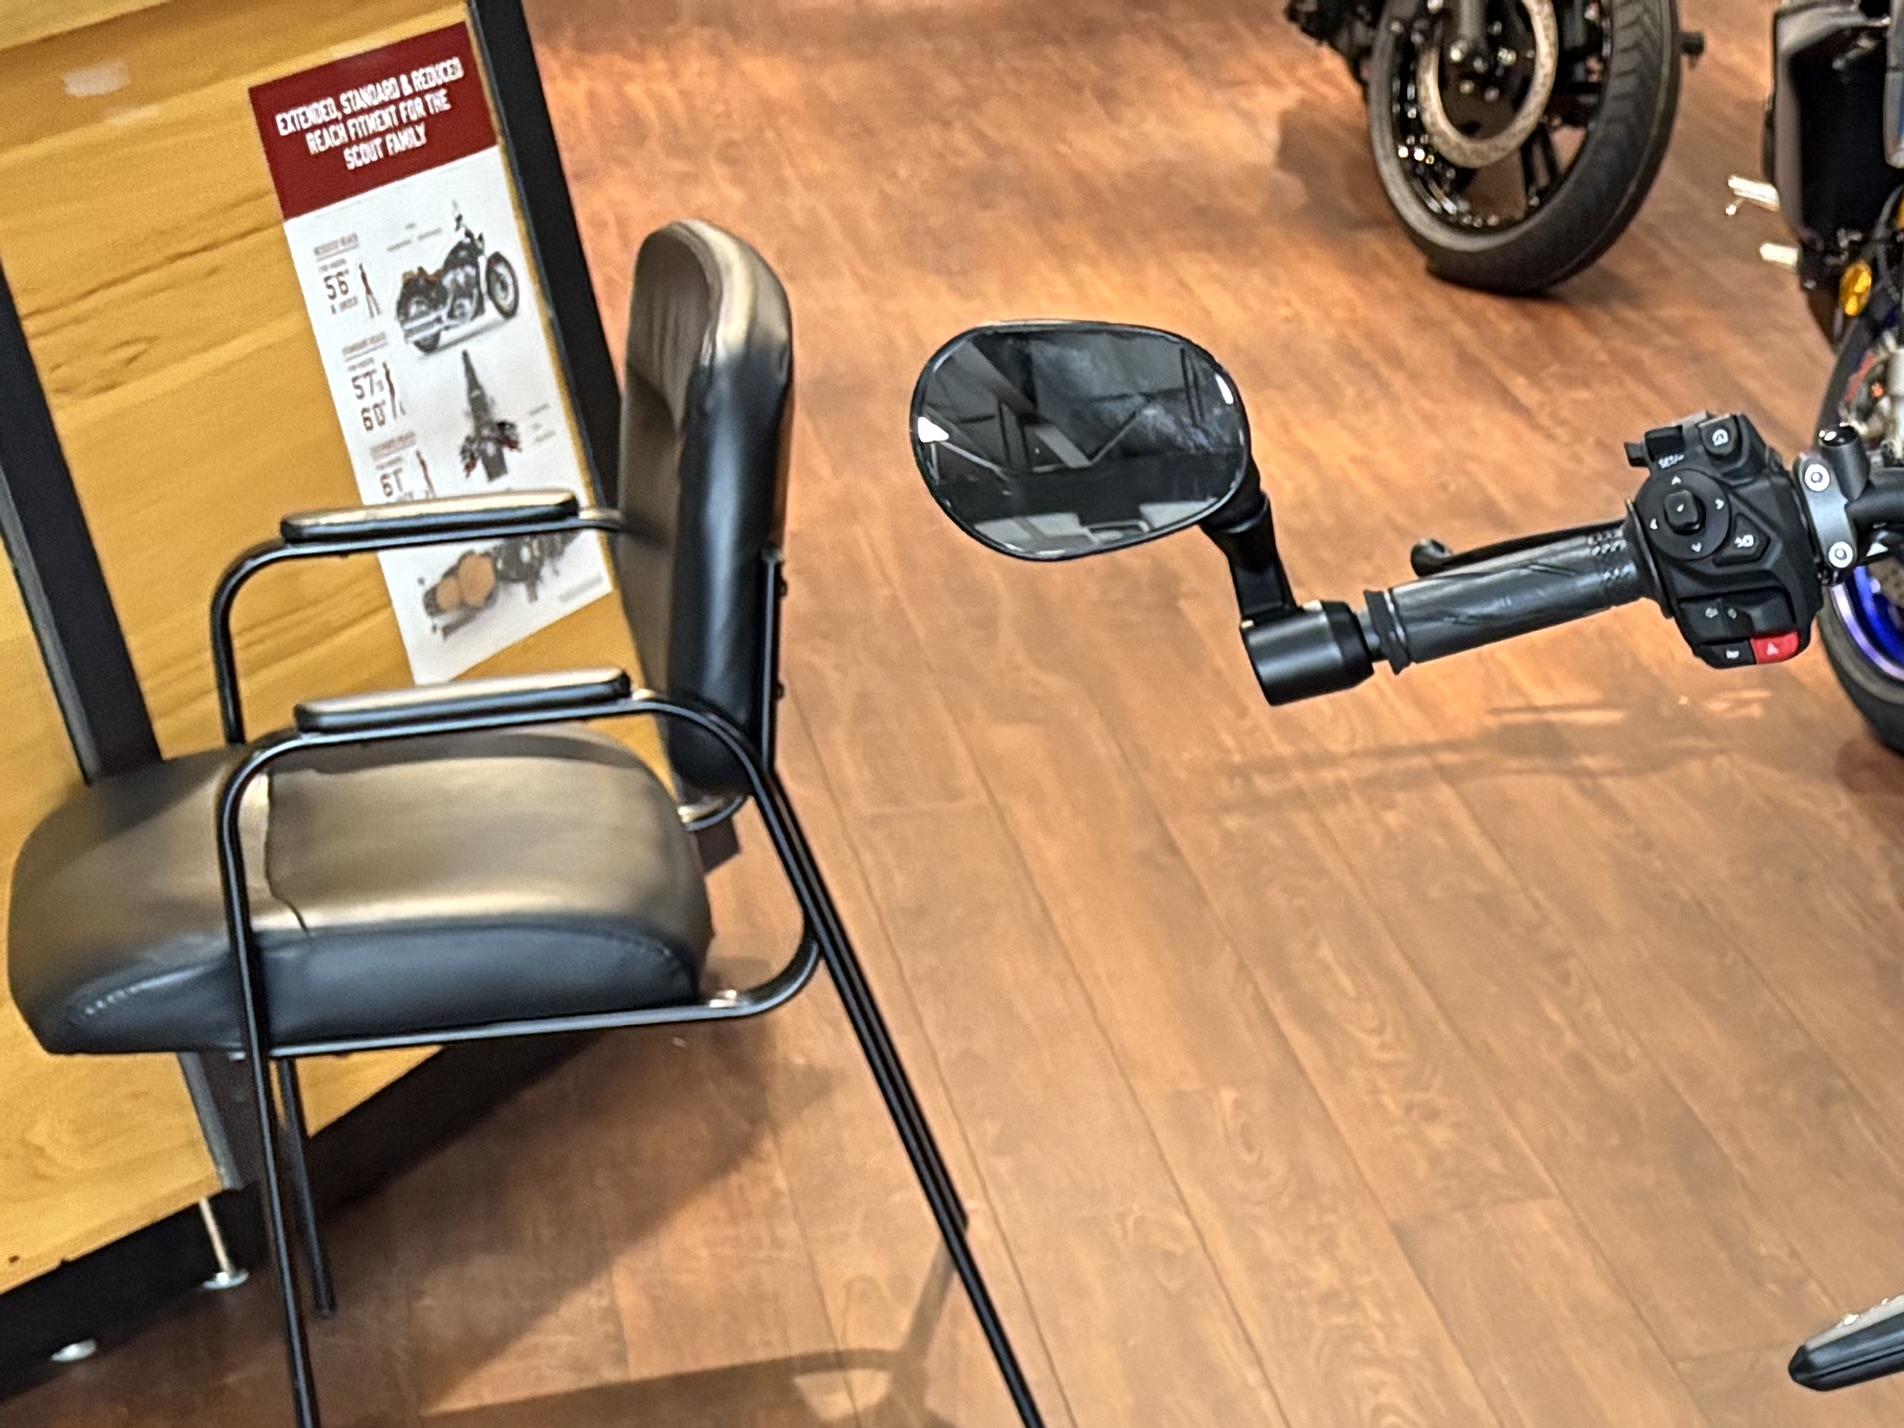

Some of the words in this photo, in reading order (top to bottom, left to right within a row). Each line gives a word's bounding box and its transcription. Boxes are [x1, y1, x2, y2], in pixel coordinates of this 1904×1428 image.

[275, 97, 342, 136] EXTENDED,
[339, 77, 400, 115] STANDARD
[400, 74, 413, 97] &
[410, 56, 464, 93] REDUCED
[305, 123, 349, 155] REACH
[347, 105, 399, 142] FITMENT
[400, 97, 427, 124] FOR
[425, 88, 451, 115] THE
[343, 137, 384, 170] SCOUT
[385, 122, 427, 156] FAMILY
